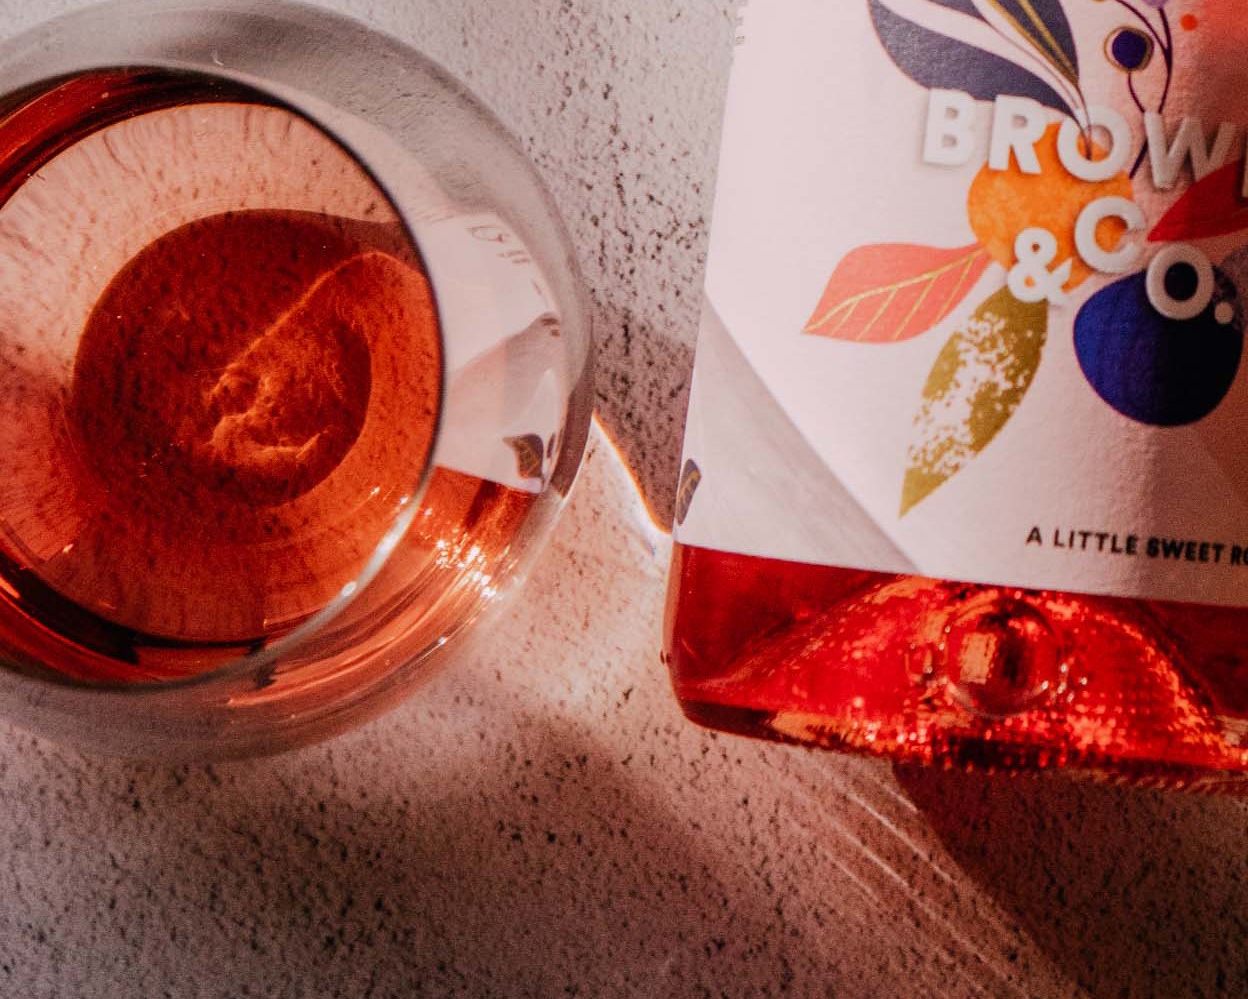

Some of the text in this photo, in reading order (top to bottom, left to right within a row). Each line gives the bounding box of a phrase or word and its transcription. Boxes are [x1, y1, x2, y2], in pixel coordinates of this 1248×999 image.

[1025, 525, 1043, 546] A
[1053, 529, 1138, 556] LITTLE
[1145, 536, 1225, 564] SWEET
